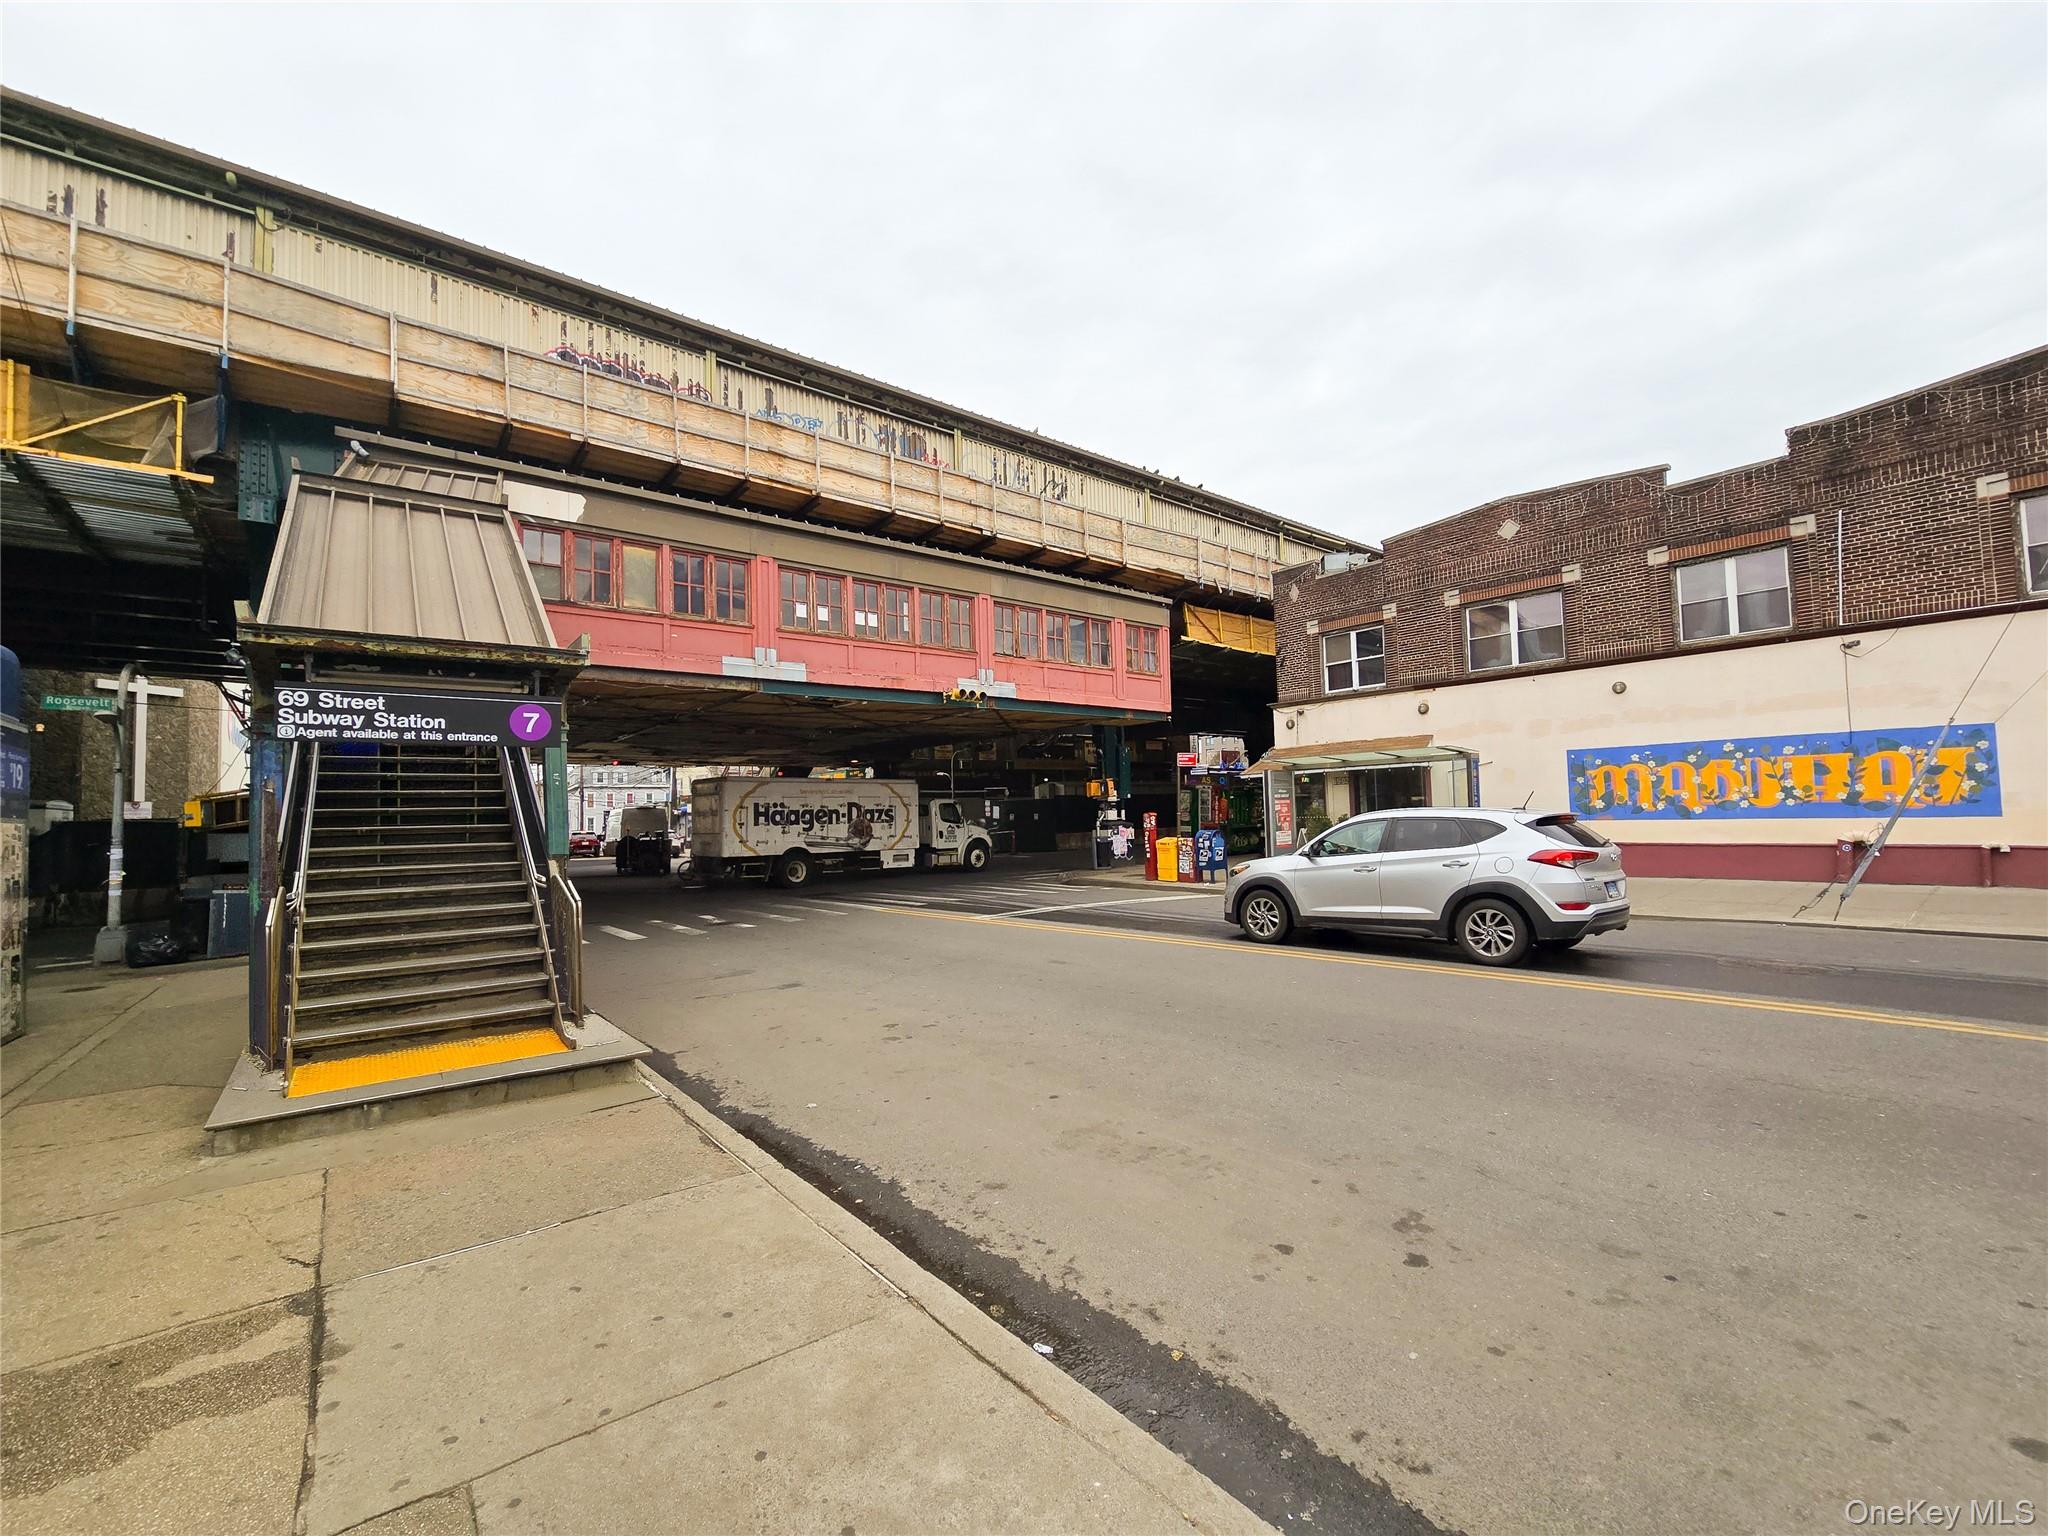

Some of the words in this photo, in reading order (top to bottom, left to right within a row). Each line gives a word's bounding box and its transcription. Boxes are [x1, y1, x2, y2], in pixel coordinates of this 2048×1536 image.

[46, 696, 110, 707] Roosevelt
[278, 690, 309, 707] 69
[318, 692, 386, 710] Street
[278, 708, 366, 729] Subway
[373, 712, 446, 729] Station
[522, 712, 540, 733] 7
[296, 727, 338, 738] Agent
[342, 729, 399, 740] available
[403, 731, 416, 740] at
[420, 731, 443, 741] this
[447, 732, 499, 742] entrance
[753, 802, 894, 832] Häagen-Dazs
